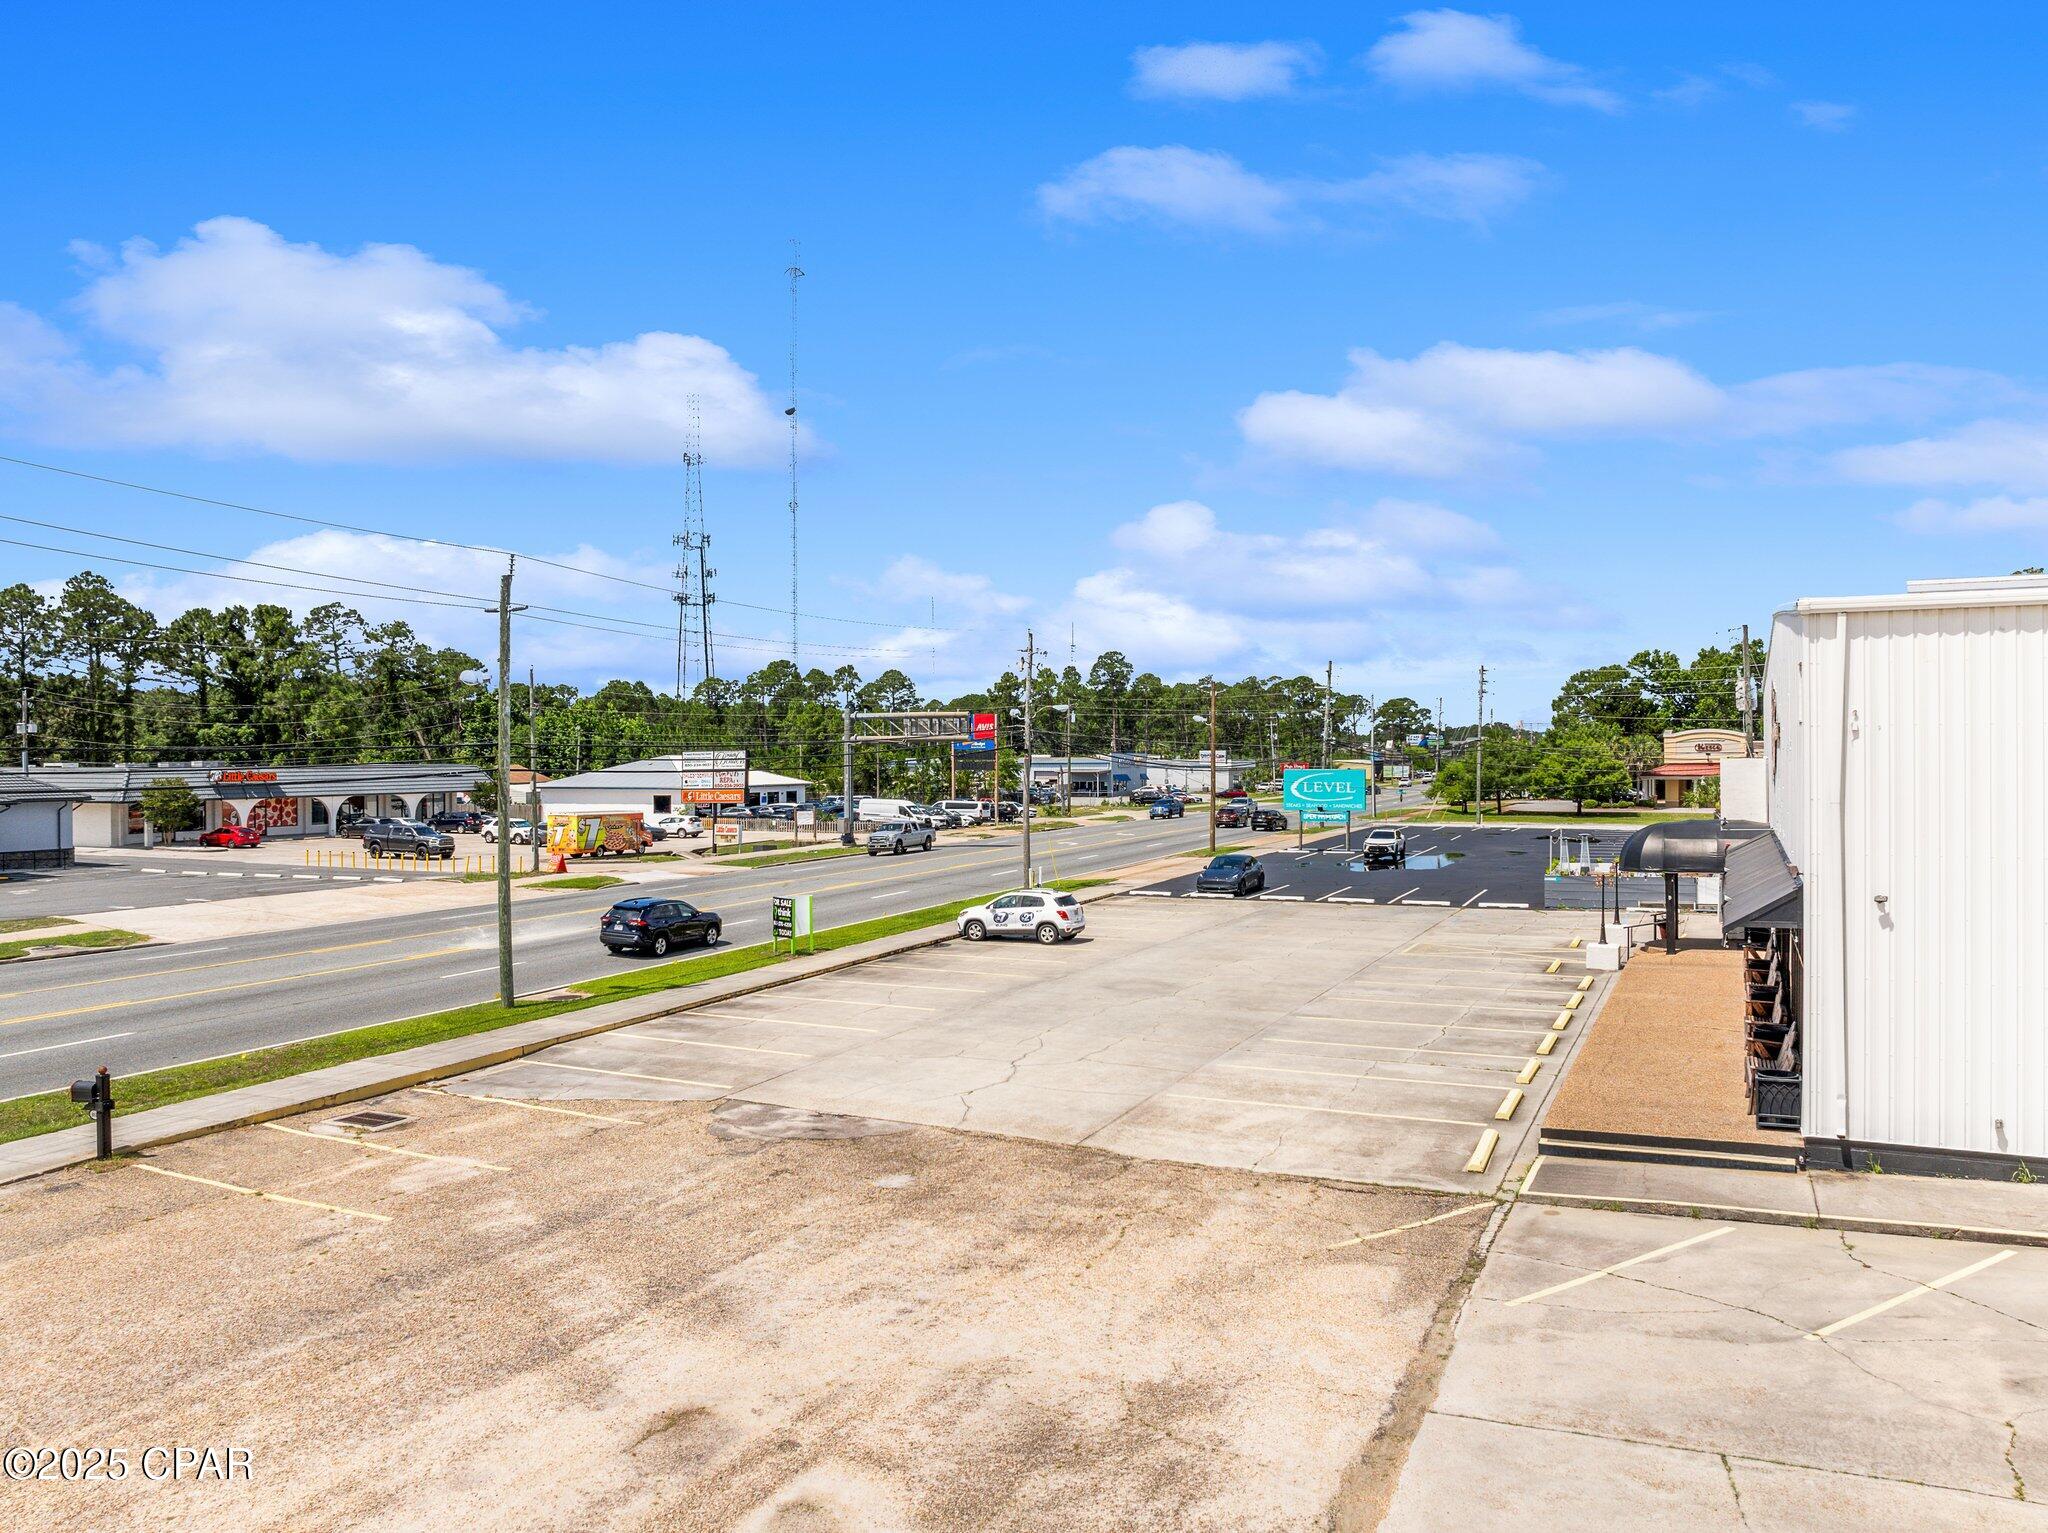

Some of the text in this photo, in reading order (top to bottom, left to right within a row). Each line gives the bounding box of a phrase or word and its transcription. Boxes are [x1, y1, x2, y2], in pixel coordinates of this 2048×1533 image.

[976, 723, 994, 731] AVIS
[223, 770, 278, 782] Little Caesars
[1302, 781, 1356, 793] LEVEL
[695, 791, 741, 801] Little Caesars
